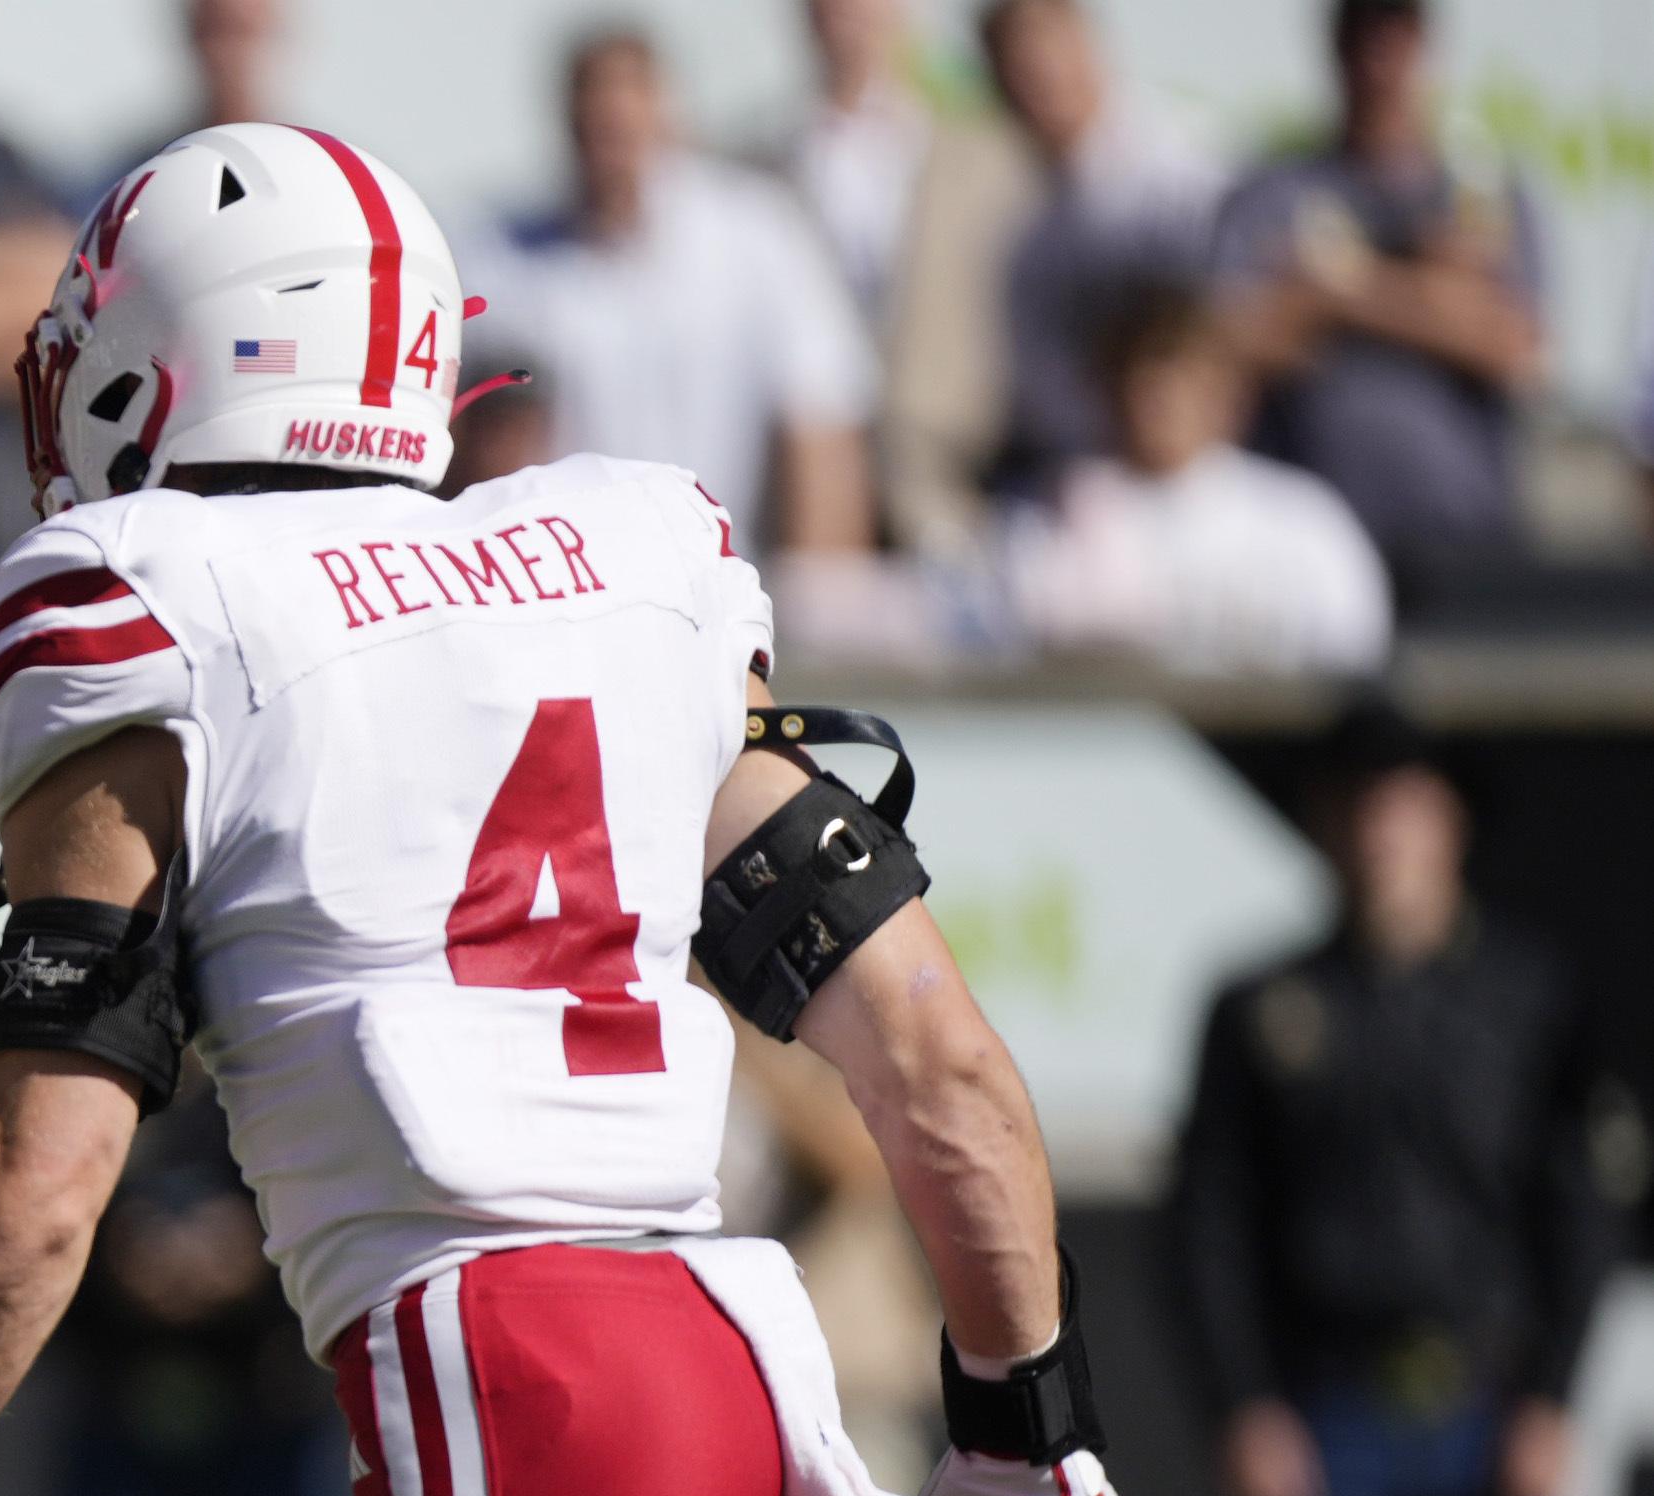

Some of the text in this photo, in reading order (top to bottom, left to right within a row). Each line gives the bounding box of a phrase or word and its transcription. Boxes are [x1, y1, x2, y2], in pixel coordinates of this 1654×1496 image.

[404, 310, 438, 389] 4
[286, 420, 427, 463] HUSKERS
[311, 516, 606, 629] REIMER
[445, 697, 668, 1077] 4
